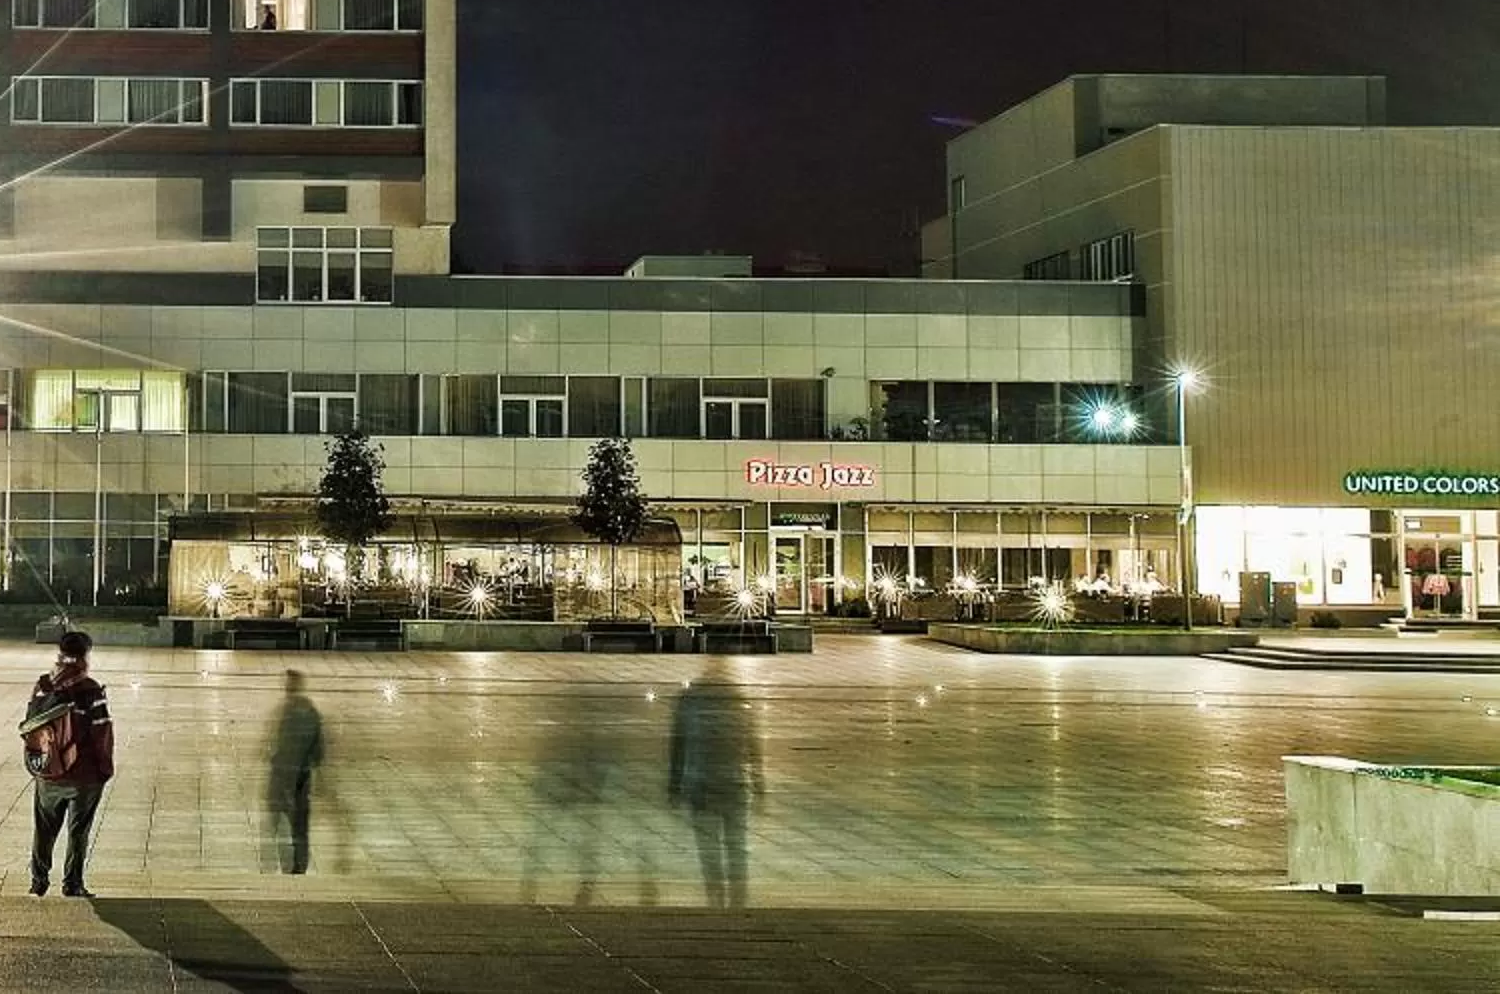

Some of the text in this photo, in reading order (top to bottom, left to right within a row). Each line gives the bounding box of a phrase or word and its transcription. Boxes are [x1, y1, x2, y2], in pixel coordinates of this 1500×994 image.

[748, 461, 874, 490] Pizza Jazz
[1345, 474, 1500, 494] UNITED COLORS
